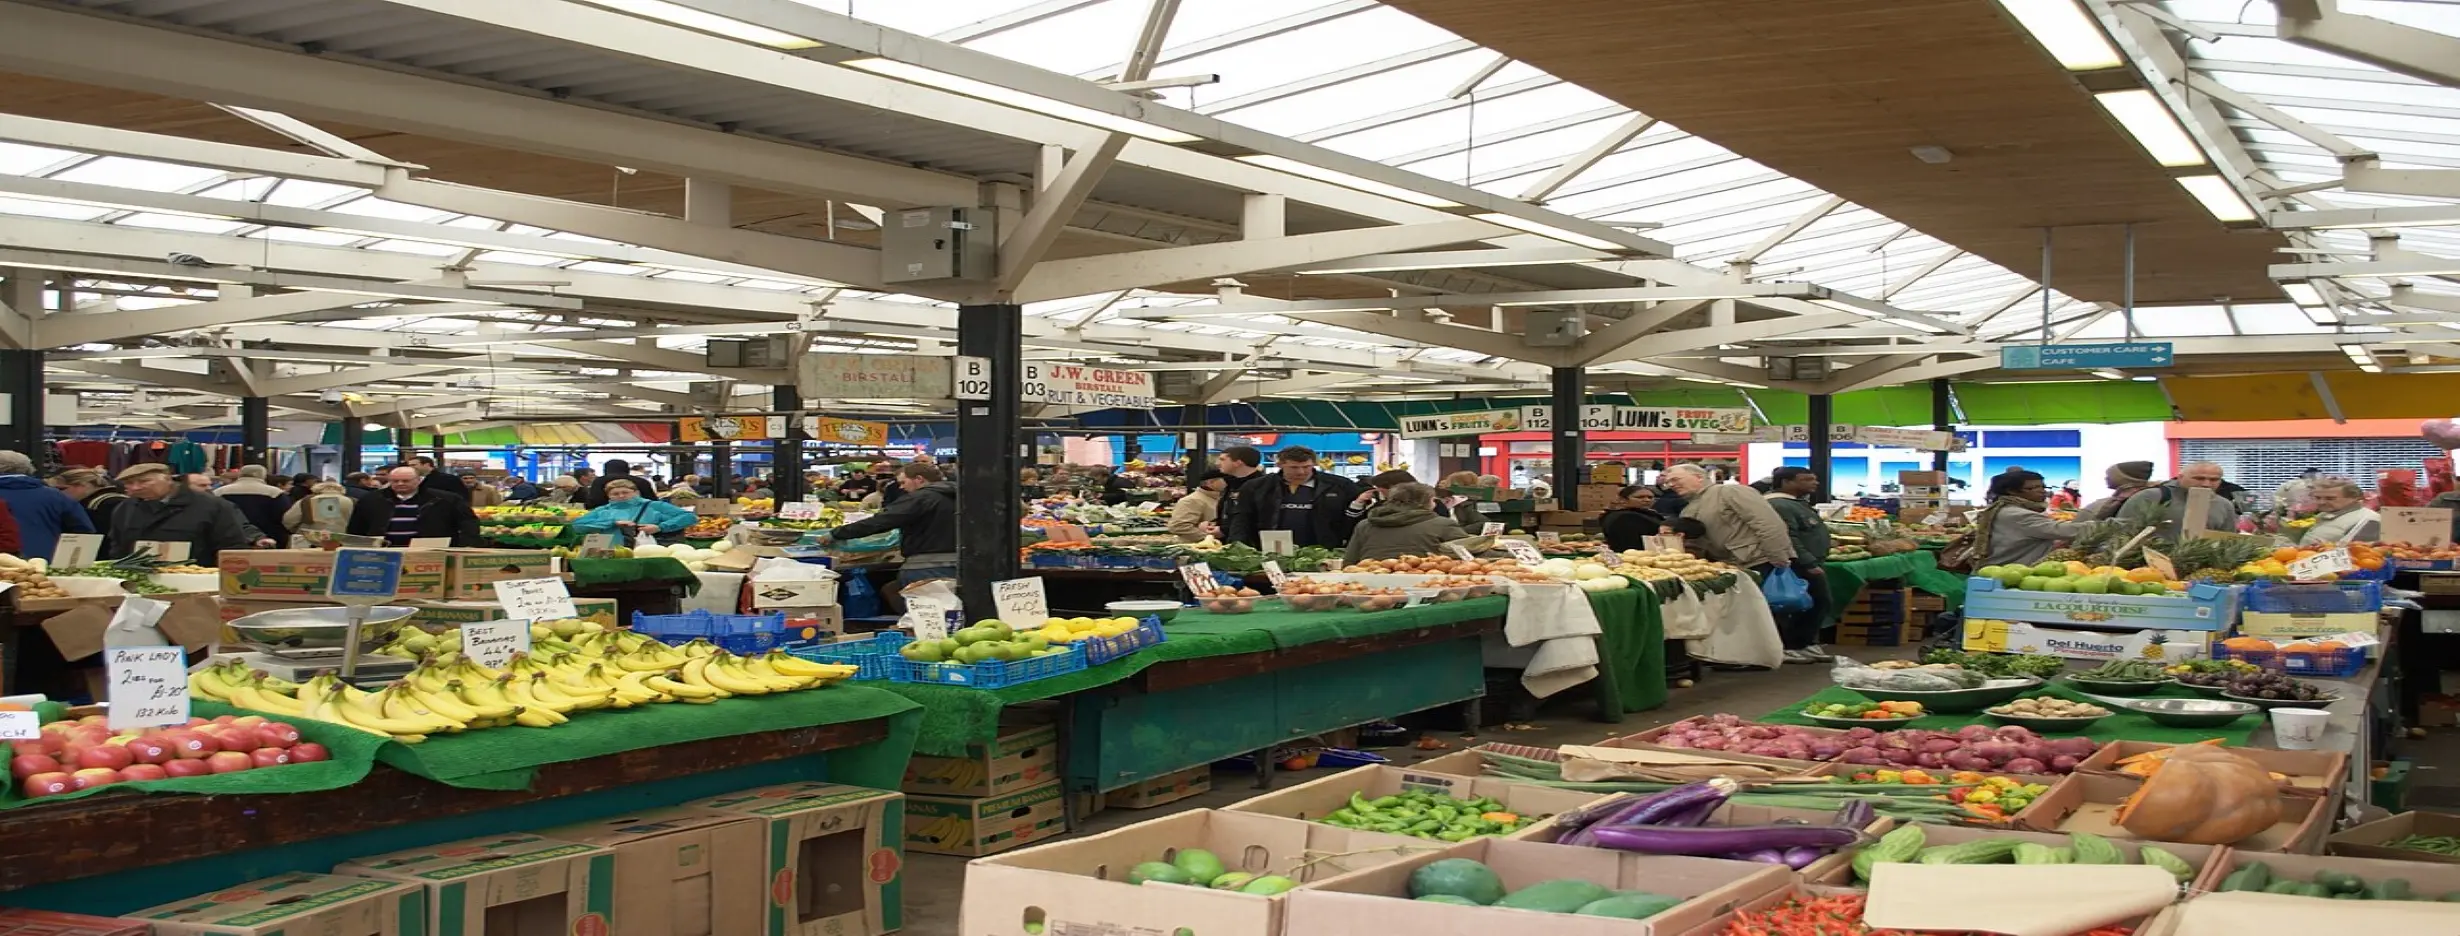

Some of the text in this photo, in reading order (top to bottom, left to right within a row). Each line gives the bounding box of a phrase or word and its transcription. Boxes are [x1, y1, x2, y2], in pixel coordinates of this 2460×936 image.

[2042, 347, 2111, 355] CUSTOMER
[969, 362, 981, 376] B
[1027, 366, 1038, 379] B
[842, 372, 917, 384] BIRSTALL
[1092, 369, 1146, 385] GREEN
[958, 380, 989, 395] 102
[1075, 382, 1124, 393] BIRSTALL
[1047, 389, 1156, 408] RUIT & VEGETABLES
[1532, 408, 1544, 417] B
[1590, 407, 1601, 415] P
[1676, 409, 1715, 419] FRUIT
[1451, 419, 1490, 430] FRUITS
[1526, 419, 1550, 428] 112
[1581, 418, 1610, 428] 104
[999, 581, 1031, 592] FRESH
[468, 627, 496, 636] BEST
[2046, 638, 2124, 653] Del Huerto
[114, 650, 180, 664] PINK LADY
